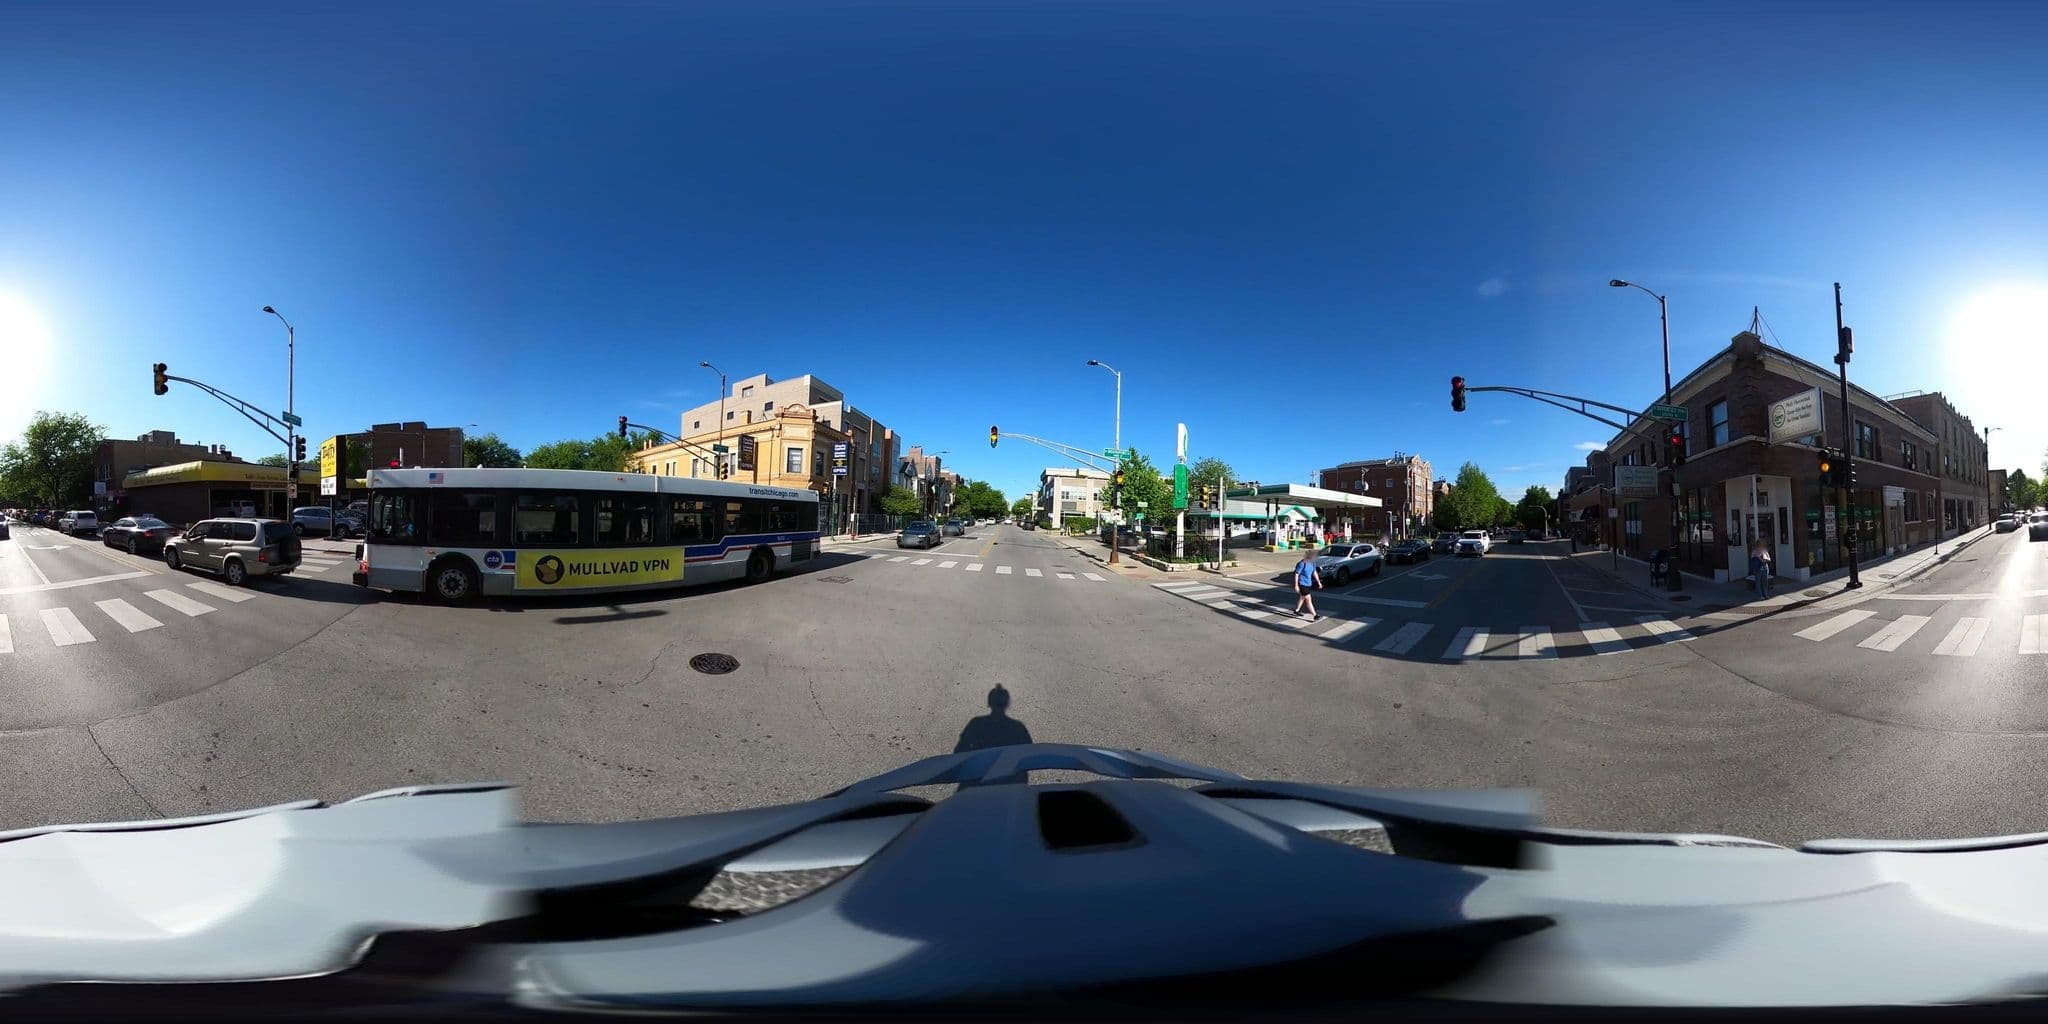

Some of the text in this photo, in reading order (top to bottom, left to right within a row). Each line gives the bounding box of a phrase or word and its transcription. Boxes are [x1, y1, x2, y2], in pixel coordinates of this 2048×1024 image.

[749, 487, 799, 498] transitchicago.com
[569, 559, 670, 576] MULLVAD VPN
